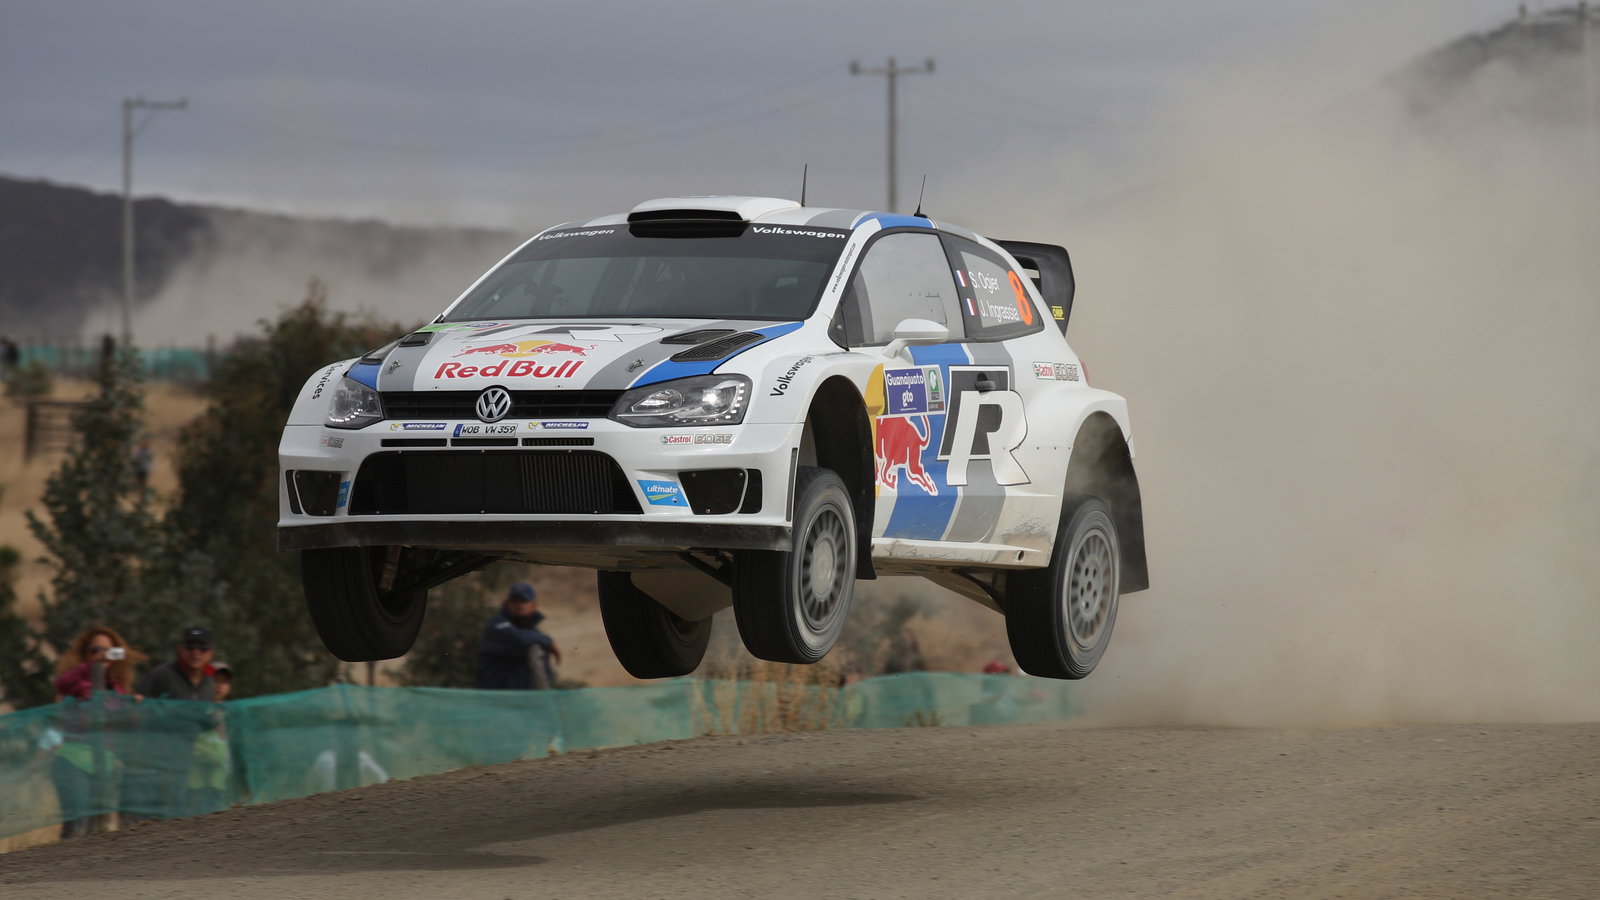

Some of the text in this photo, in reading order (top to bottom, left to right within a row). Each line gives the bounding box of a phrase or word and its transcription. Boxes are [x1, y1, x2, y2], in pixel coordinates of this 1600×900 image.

[539, 229, 615, 241] Volkswagen
[752, 226, 846, 239] Volkswagen
[968, 271, 1000, 294] S. Ogier
[1008, 270, 1033, 326] 8
[980, 300, 1021, 323] J. Ingrassia
[434, 360, 585, 379] Red Bull
[1054, 363, 1079, 381] EDGE
[886, 372, 925, 389] Guanajuato
[902, 390, 914, 408] gto
[484, 426, 498, 434] VW
[497, 426, 515, 434] 359
[668, 433, 732, 444] Castrol EDGE
[942, 384, 1032, 486] R
[647, 485, 678, 493] ultimate
